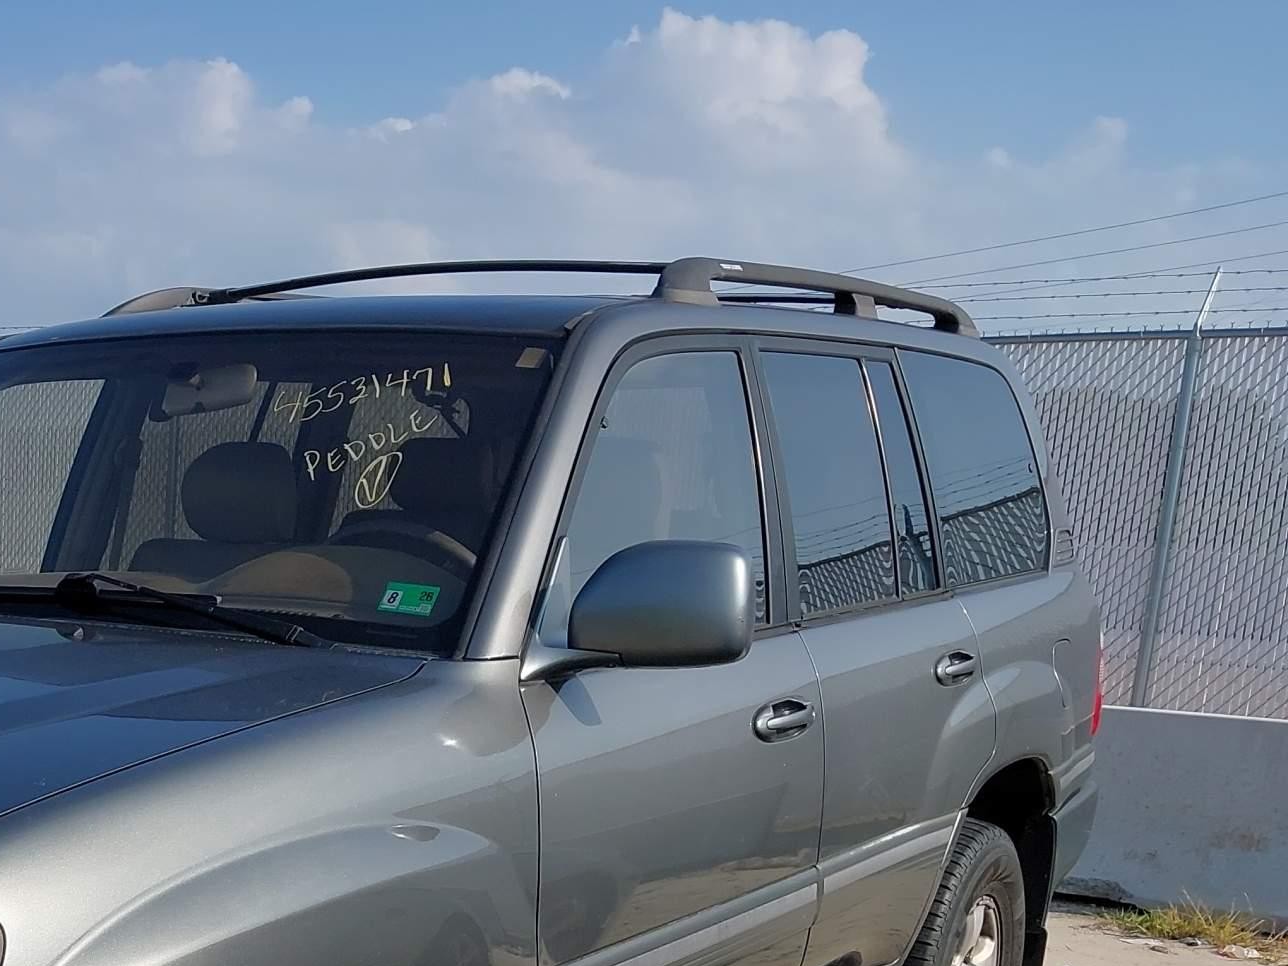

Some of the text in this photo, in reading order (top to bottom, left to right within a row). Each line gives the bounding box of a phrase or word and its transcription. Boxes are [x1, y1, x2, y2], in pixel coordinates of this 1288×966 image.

[273, 362, 452, 424] 45531471
[303, 408, 439, 482] PEDDLE
[387, 591, 400, 604] 8
